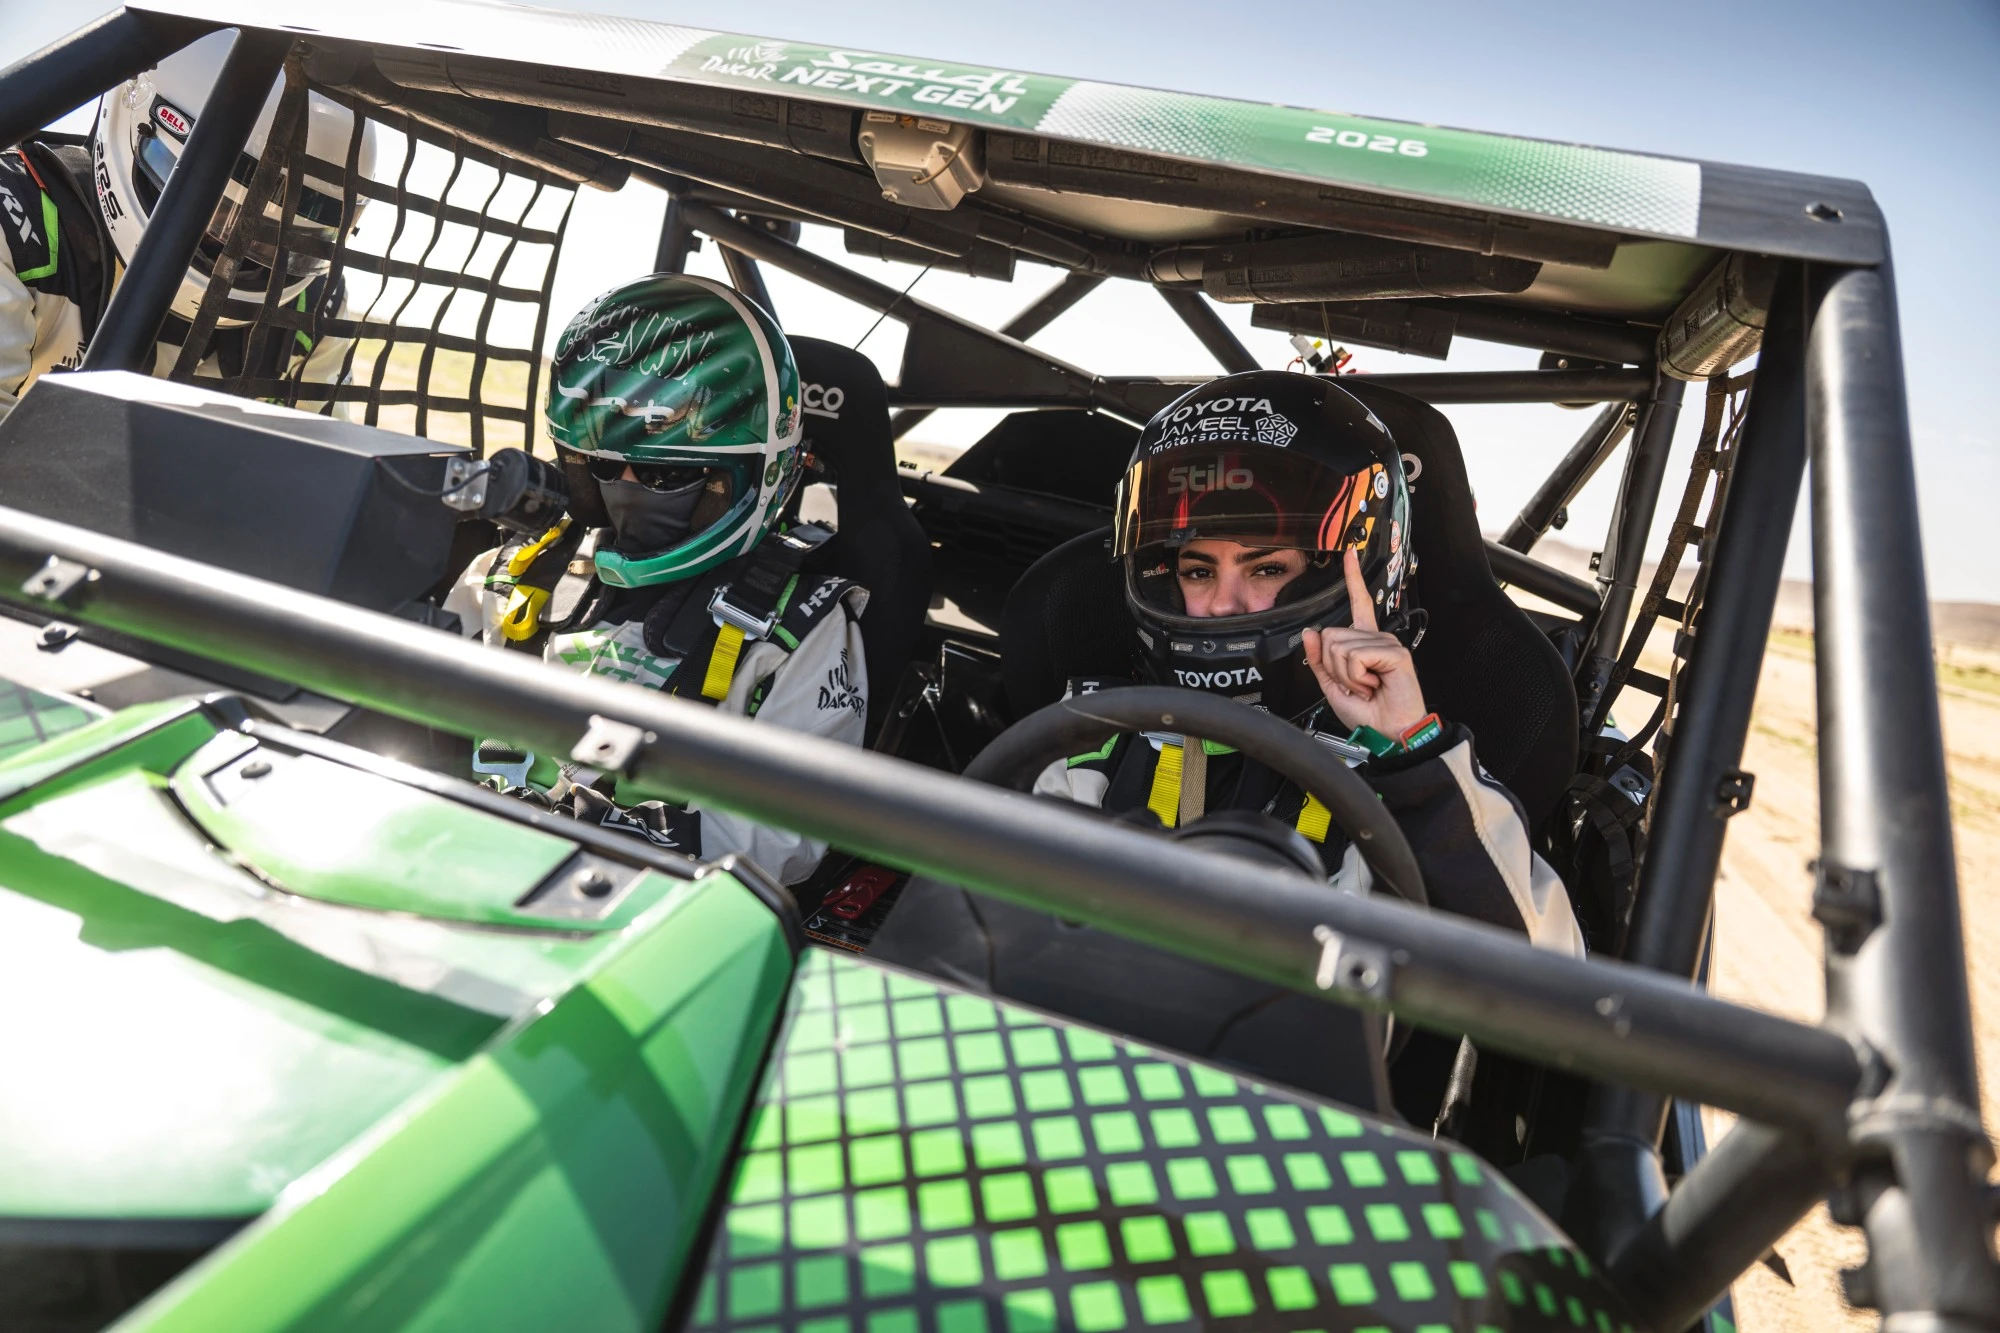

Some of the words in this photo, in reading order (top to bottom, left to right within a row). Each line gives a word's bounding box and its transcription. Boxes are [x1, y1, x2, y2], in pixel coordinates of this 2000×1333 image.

[700, 56, 777, 82] DAKAR
[780, 67, 916, 97] NEXT
[912, 85, 1018, 114] GEN
[160, 108, 185, 132] BELL
[1305, 126, 1428, 157] 2026
[1161, 397, 1273, 429] TOYOTA
[1149, 432, 1249, 455] motorsport
[1154, 416, 1250, 445] JAMEEL
[1167, 455, 1254, 494] Stilo
[1143, 564, 1169, 578] Stilo
[799, 577, 848, 617] HRX
[1174, 667, 1263, 688] TOYOTA
[818, 686, 865, 718] DAKAR
